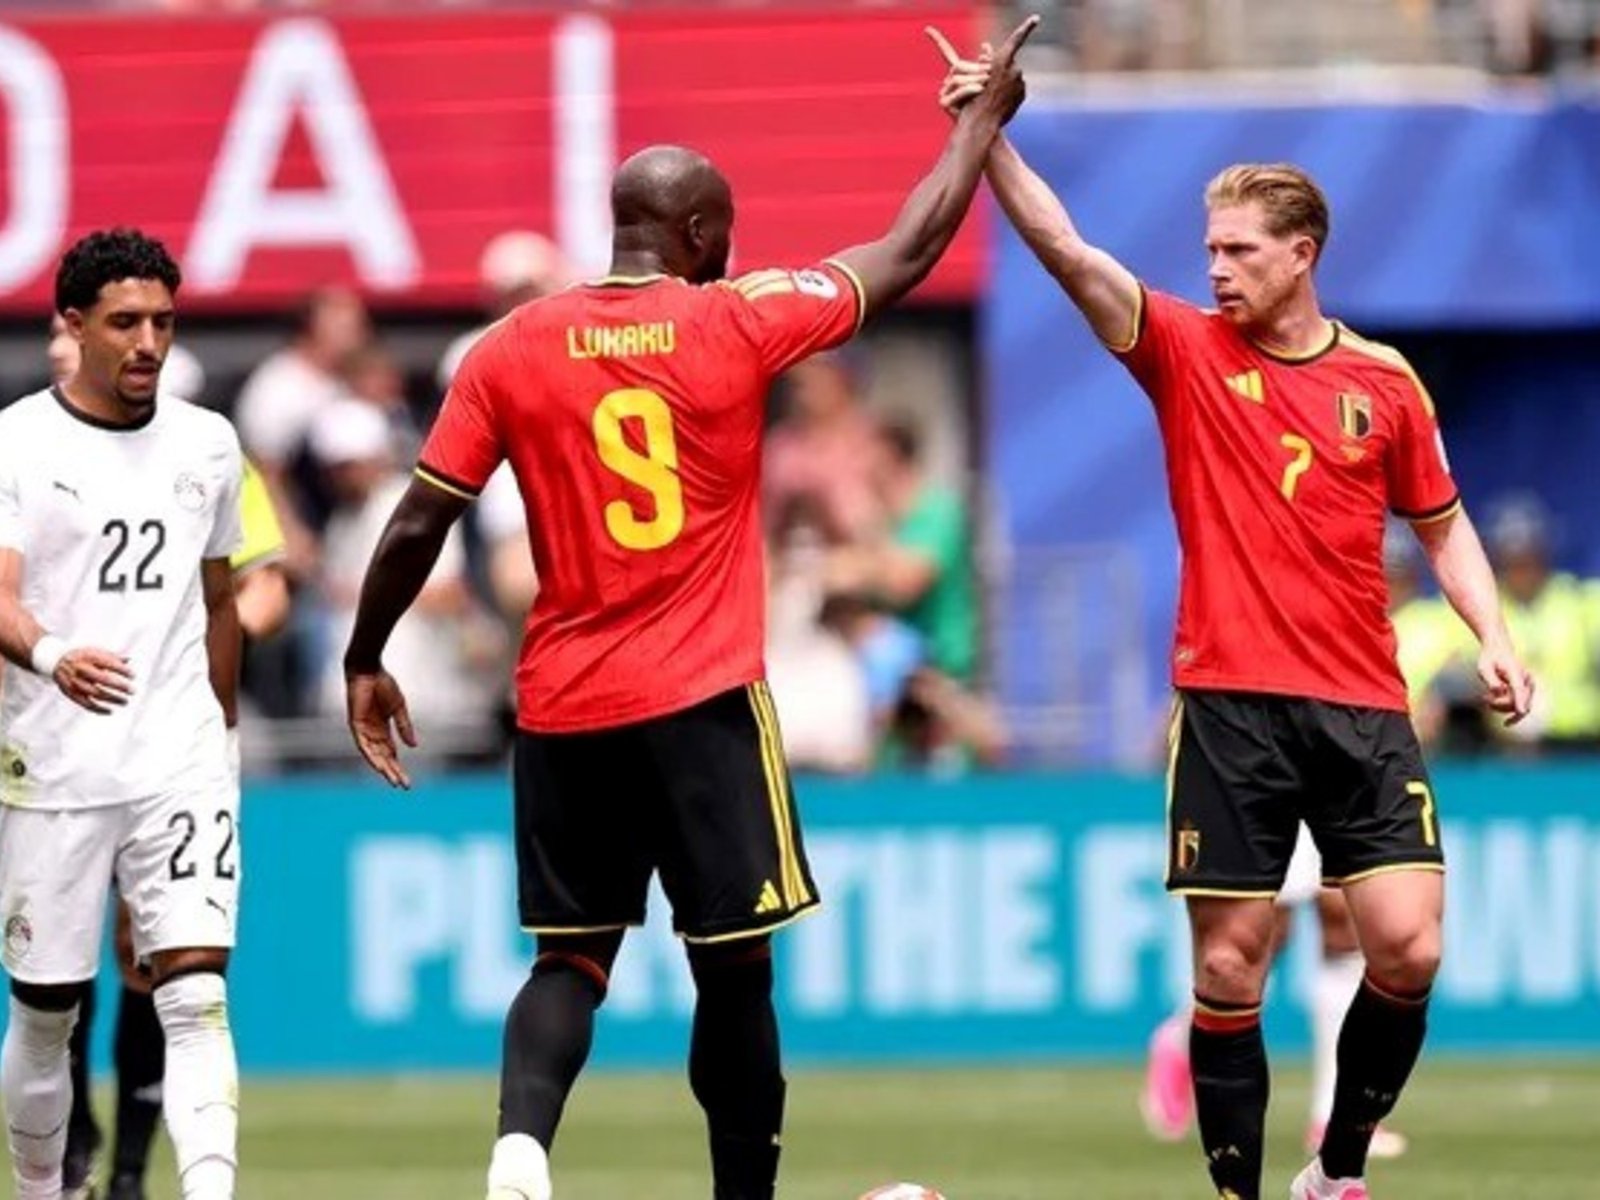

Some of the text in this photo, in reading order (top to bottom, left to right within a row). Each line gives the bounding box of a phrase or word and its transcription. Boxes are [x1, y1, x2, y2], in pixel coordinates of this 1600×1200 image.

[566, 320, 676, 359] LUKAKU
[592, 388, 685, 551] 9
[1280, 433, 1313, 501] 7
[98, 519, 166, 592] 22
[167, 809, 236, 881] 22
[1405, 780, 1436, 847] 7
[793, 823, 1061, 1017] THE
